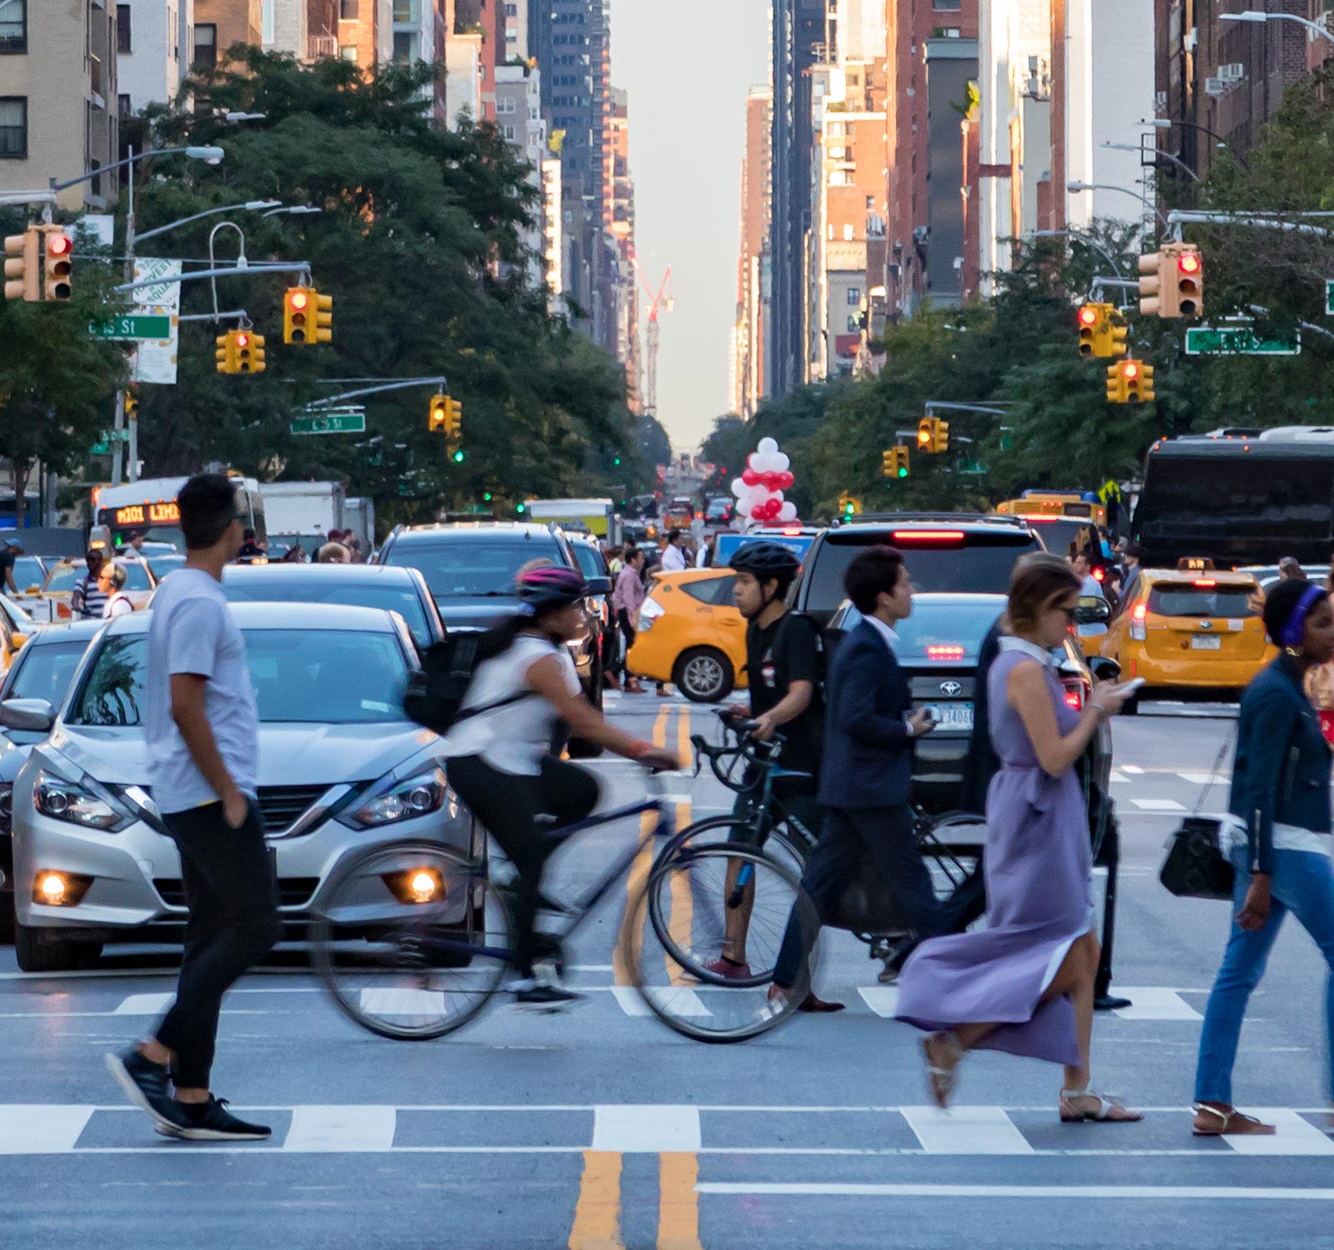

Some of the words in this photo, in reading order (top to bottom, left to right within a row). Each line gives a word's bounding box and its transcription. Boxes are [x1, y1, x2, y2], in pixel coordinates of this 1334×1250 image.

[121, 319, 136, 335] St
[117, 506, 145, 524] M101
[149, 503, 181, 521] LIMI
